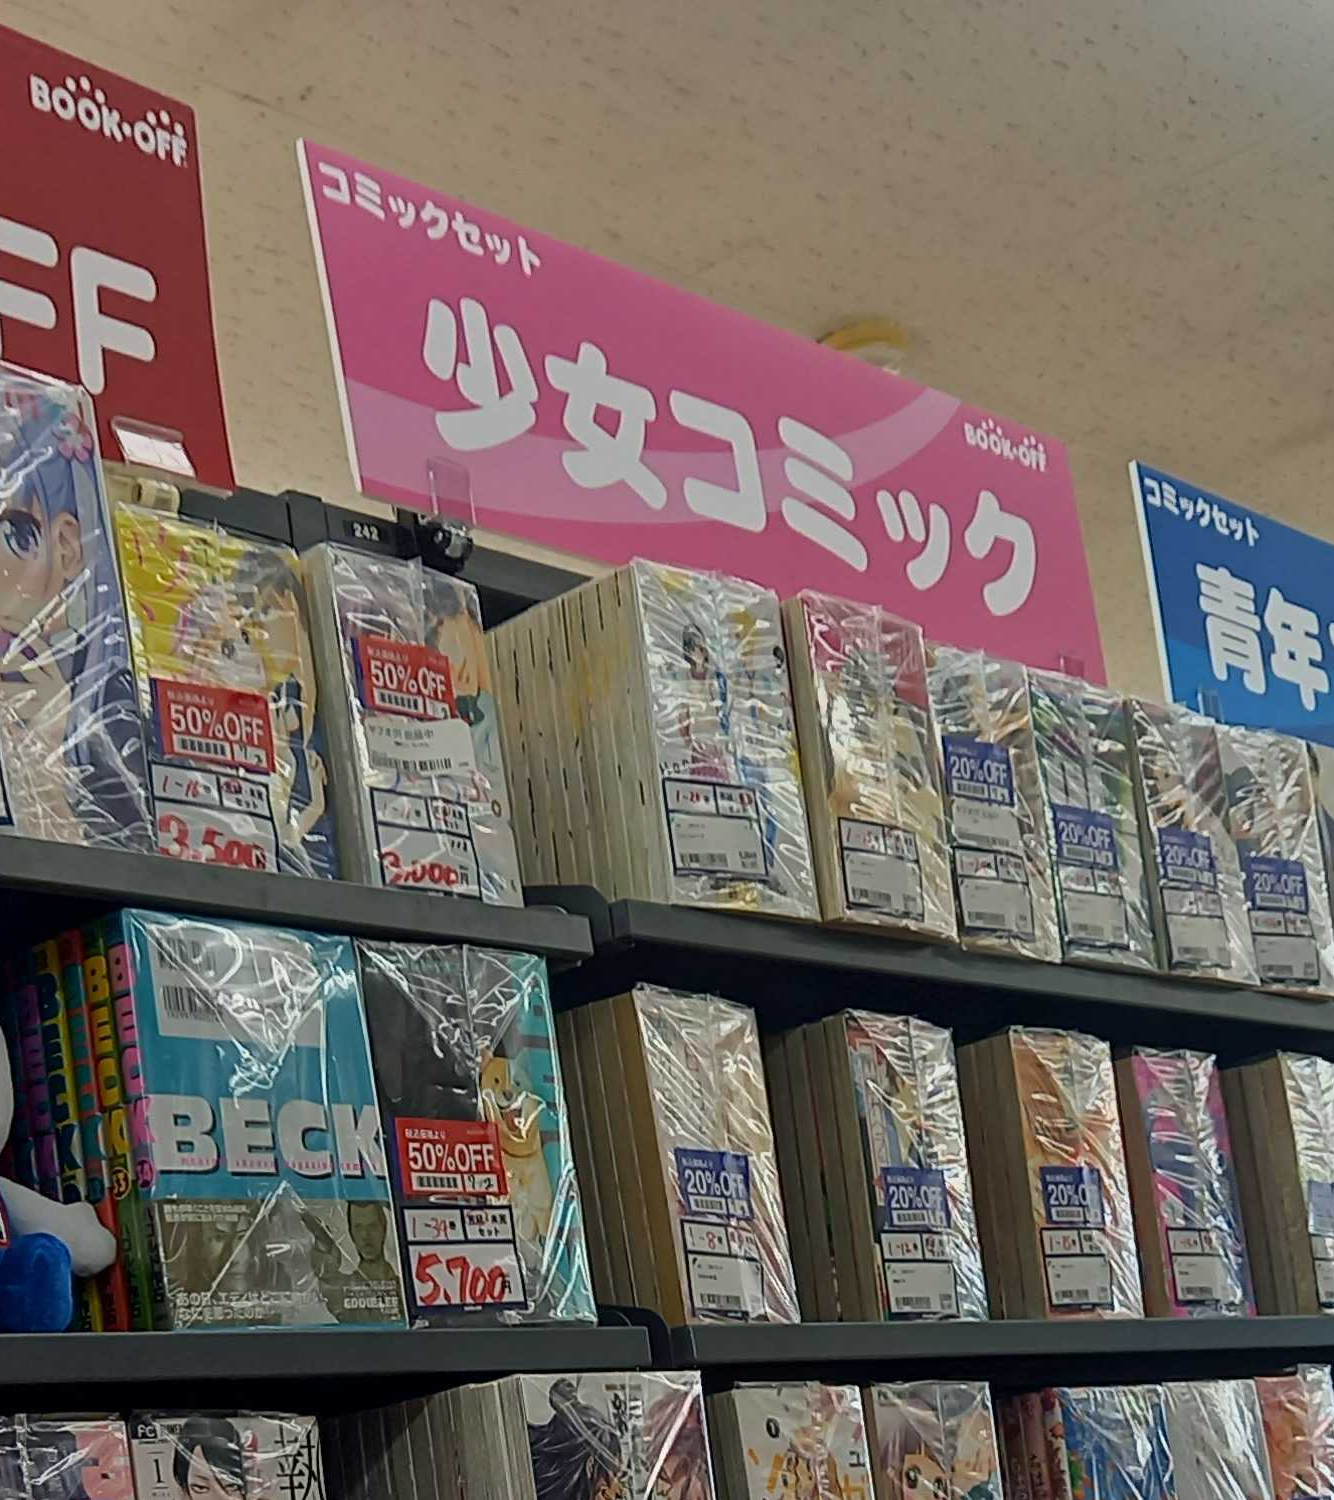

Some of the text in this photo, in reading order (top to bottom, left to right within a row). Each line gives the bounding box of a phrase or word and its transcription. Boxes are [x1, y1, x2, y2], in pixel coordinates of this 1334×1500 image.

[317, 161, 542, 276] コミックセット
[422, 296, 1037, 617] 少女コミック
[1144, 475, 1260, 547] コミックセット
[352, 523, 380, 542] 242
[370, 659, 447, 700] 50%OFF
[170, 702, 264, 746] 50%OFF
[951, 754, 1008, 787] 20%OFF
[1057, 820, 1112, 850] 20%OFF
[152, 1094, 389, 1180] BECK
[408, 1142, 496, 1172] 50%OFF
[684, 1168, 746, 1200] 20%OFF
[889, 1184, 942, 1210] 20%OFF
